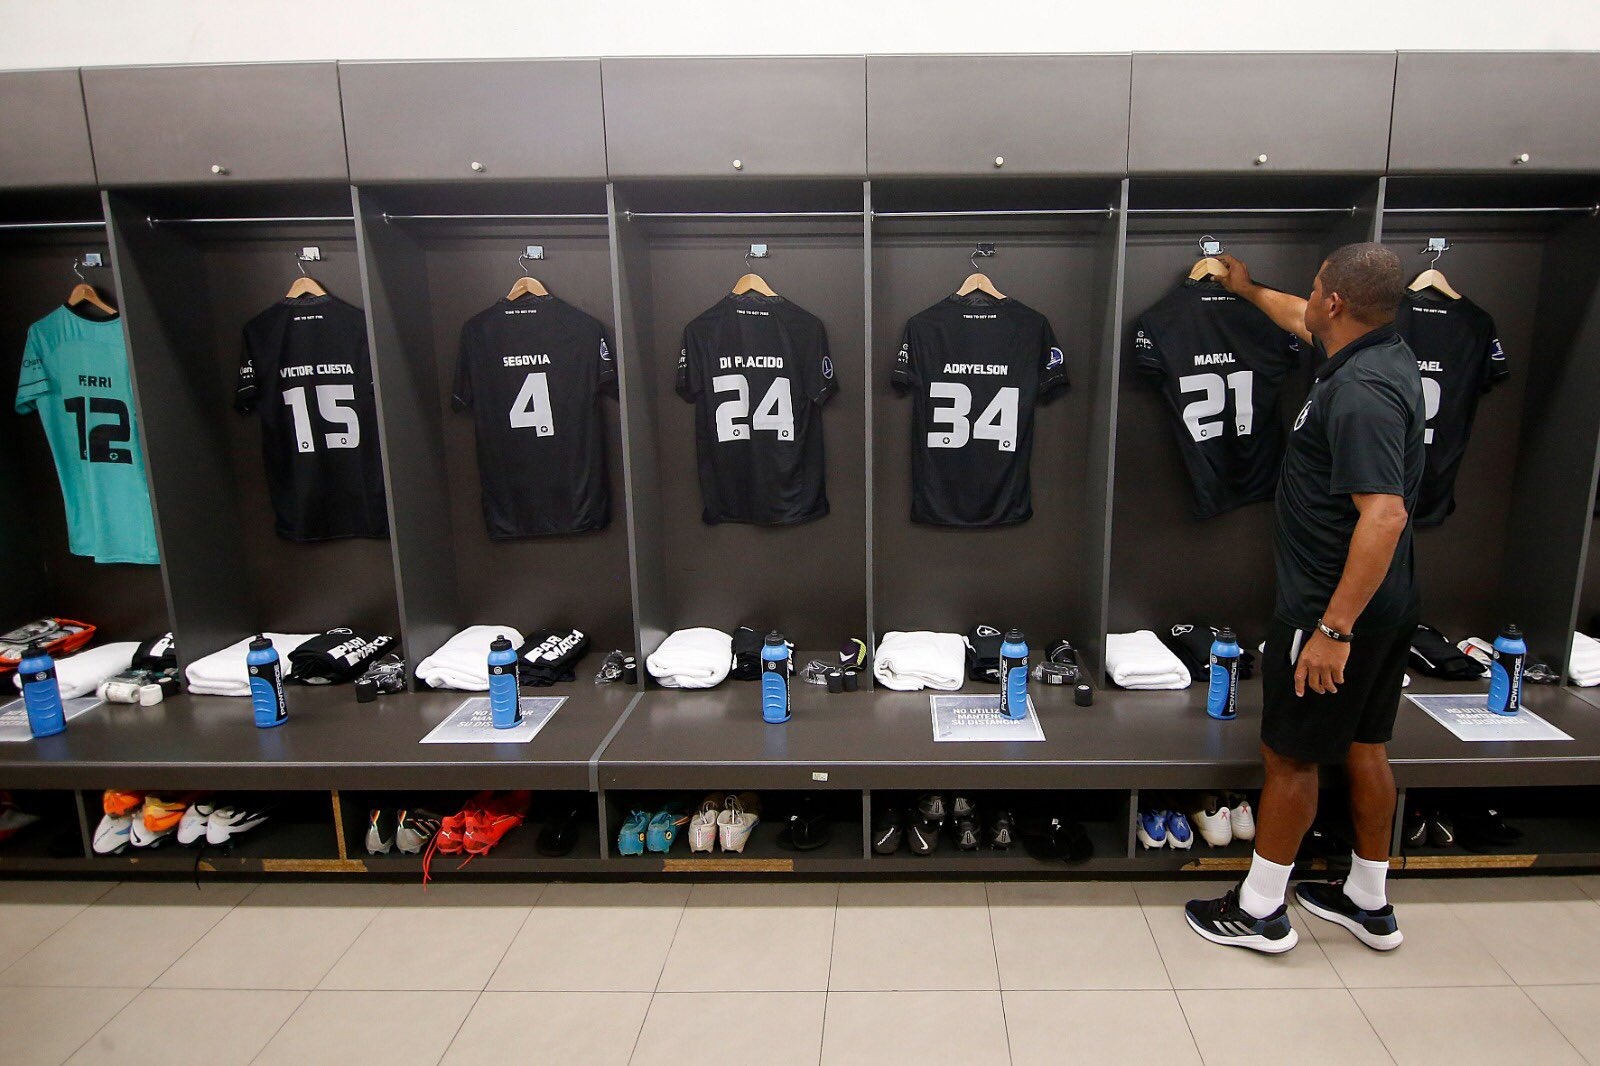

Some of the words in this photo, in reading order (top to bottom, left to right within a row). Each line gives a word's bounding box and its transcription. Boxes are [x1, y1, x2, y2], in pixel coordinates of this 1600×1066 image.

[280, 365, 315, 378] VICTOR
[316, 363, 354, 375] CUESTA
[502, 353, 551, 367] SEGOVIA
[719, 356, 732, 369] DI
[943, 363, 1008, 376] ADRYELSON
[64, 396, 133, 465] 12
[282, 384, 360, 453] 15
[509, 372, 555, 437] 4
[712, 373, 795, 442] 24
[927, 381, 1020, 452] 34
[1179, 370, 1253, 442] 21
[326, 636, 368, 660] PARI
[272, 661, 286, 716] POWERADE
[1000, 659, 1009, 711] POWERADE
[1228, 659, 1238, 713] POWERADE
[1510, 656, 1522, 709] POWERADE
